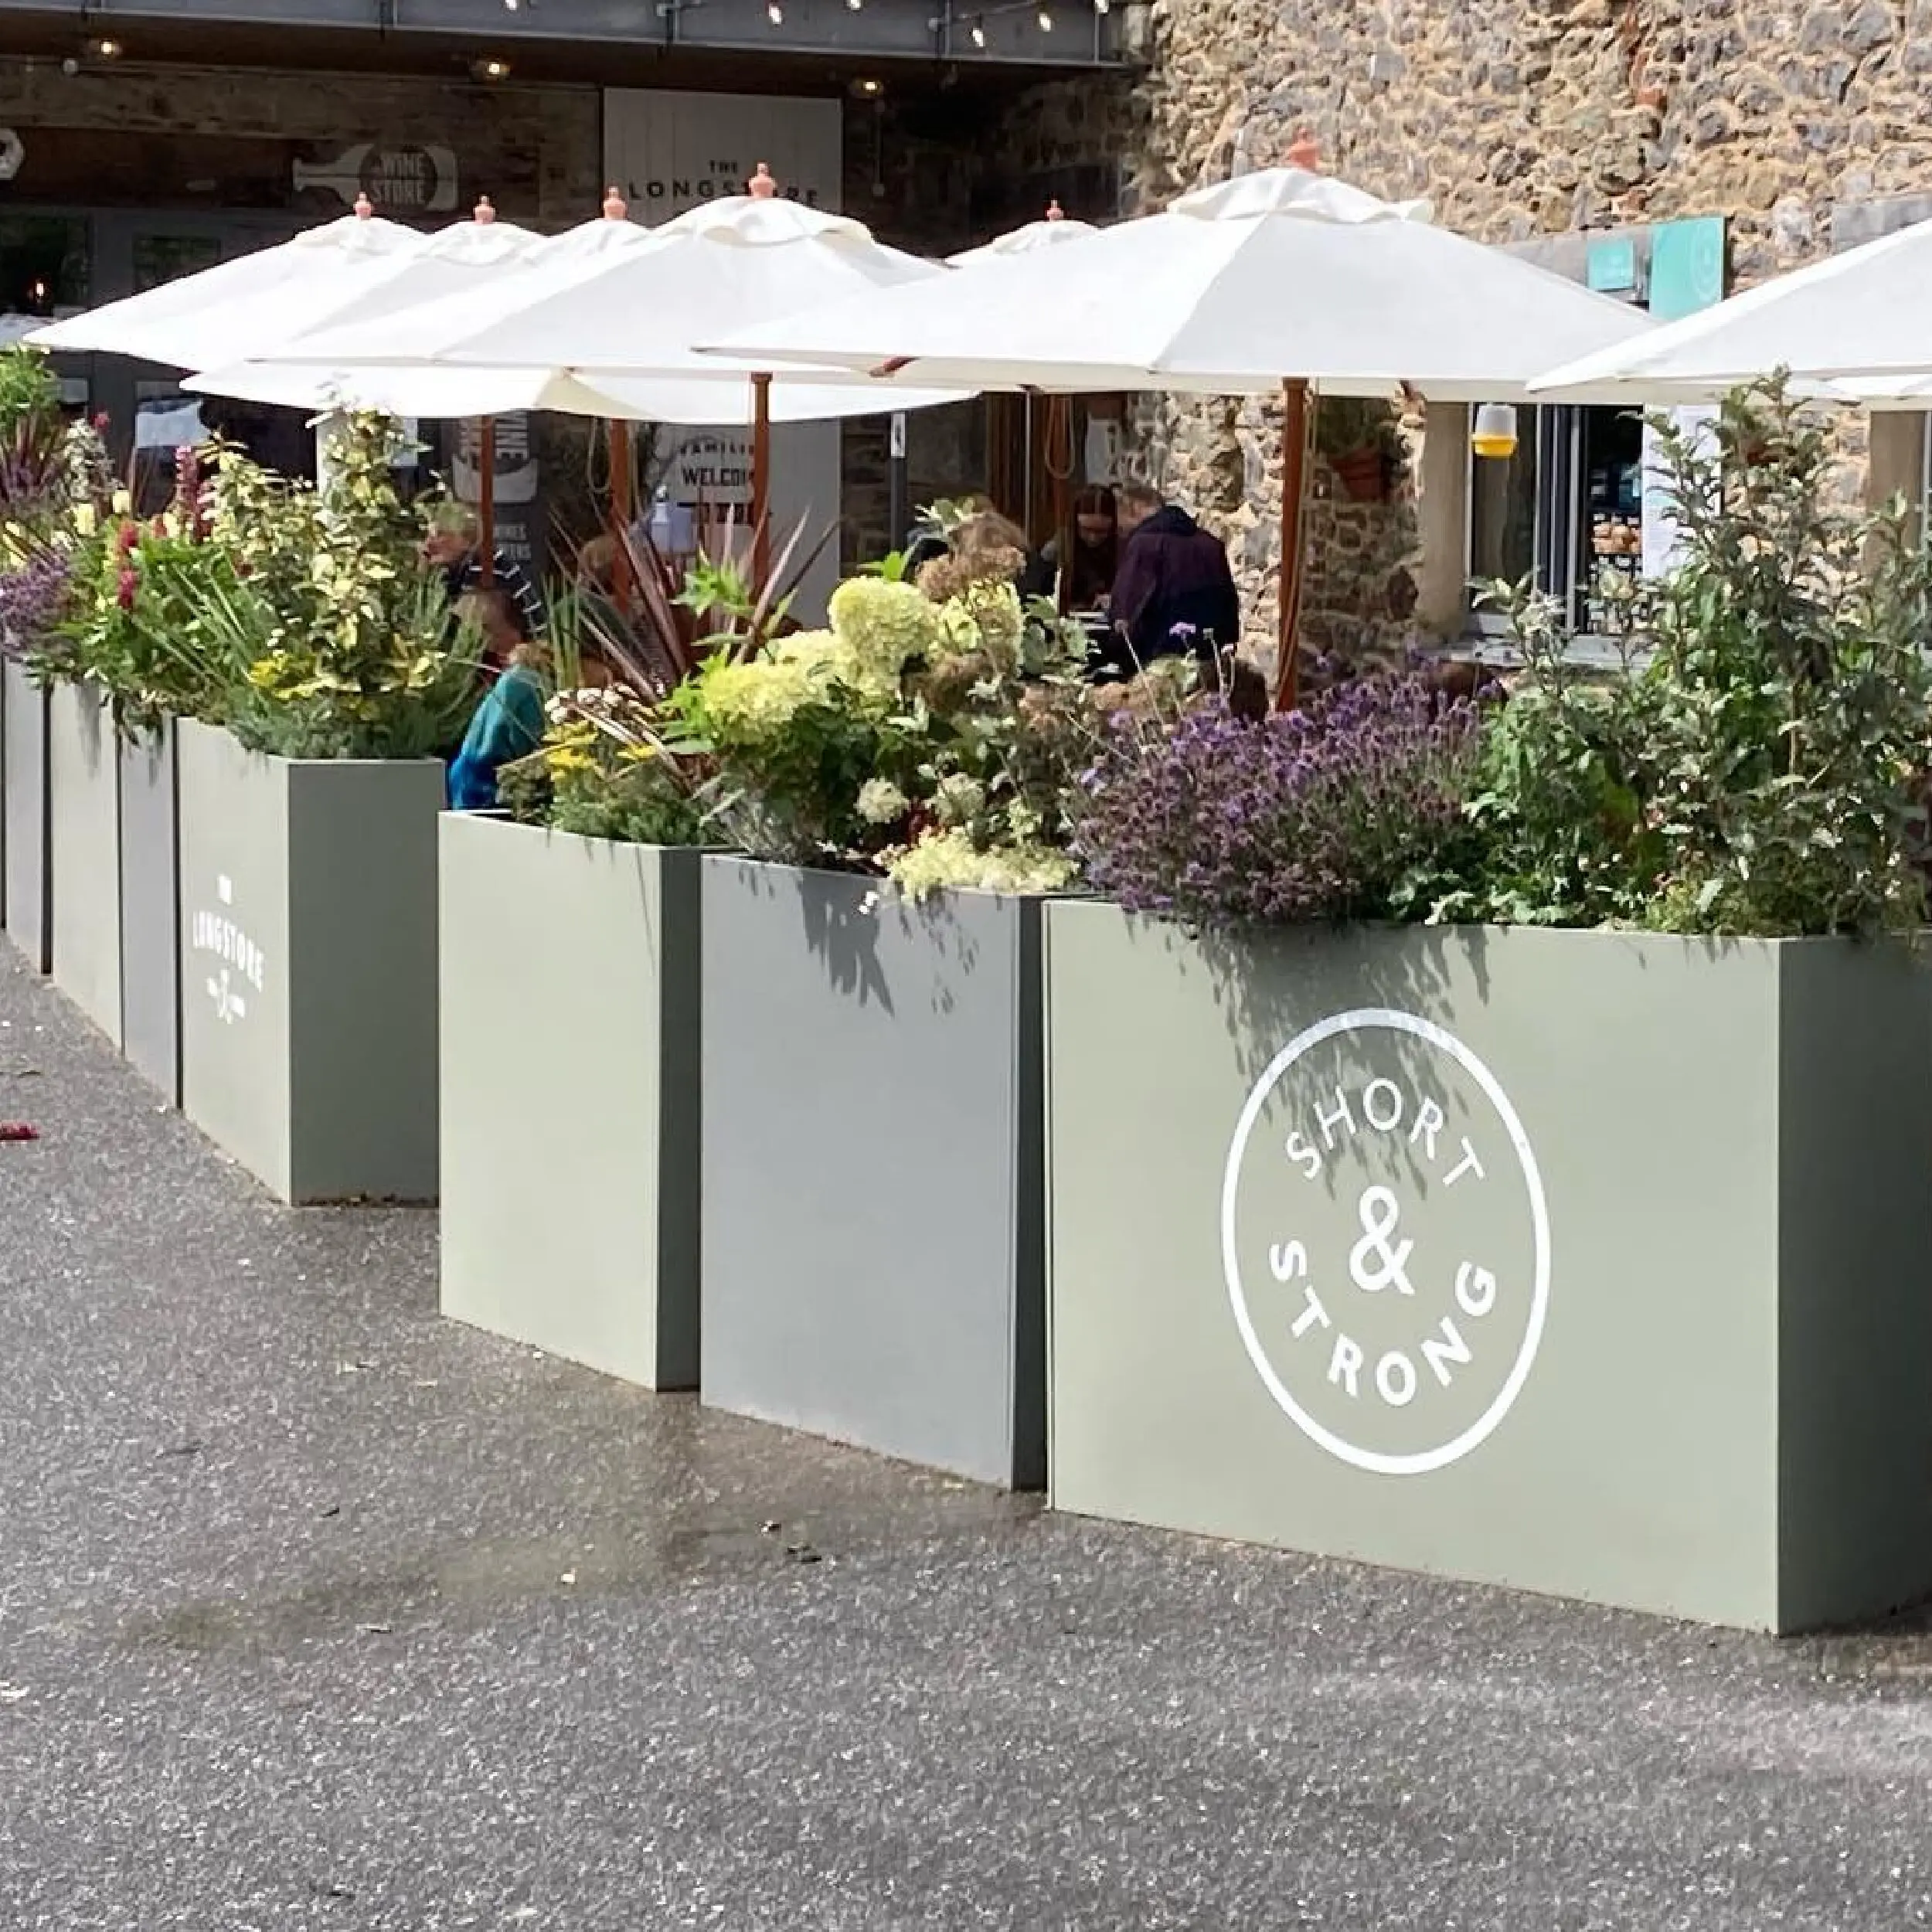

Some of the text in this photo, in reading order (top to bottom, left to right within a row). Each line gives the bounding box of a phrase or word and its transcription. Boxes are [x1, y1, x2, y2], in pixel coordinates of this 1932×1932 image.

[628, 179, 818, 203] LONGSRE
[192, 909, 264, 994] LONGSTORE
[1285, 1078, 1485, 1186] SHORT
[1349, 1185, 1415, 1295] &
[1269, 1239, 1496, 1406] STRONG
